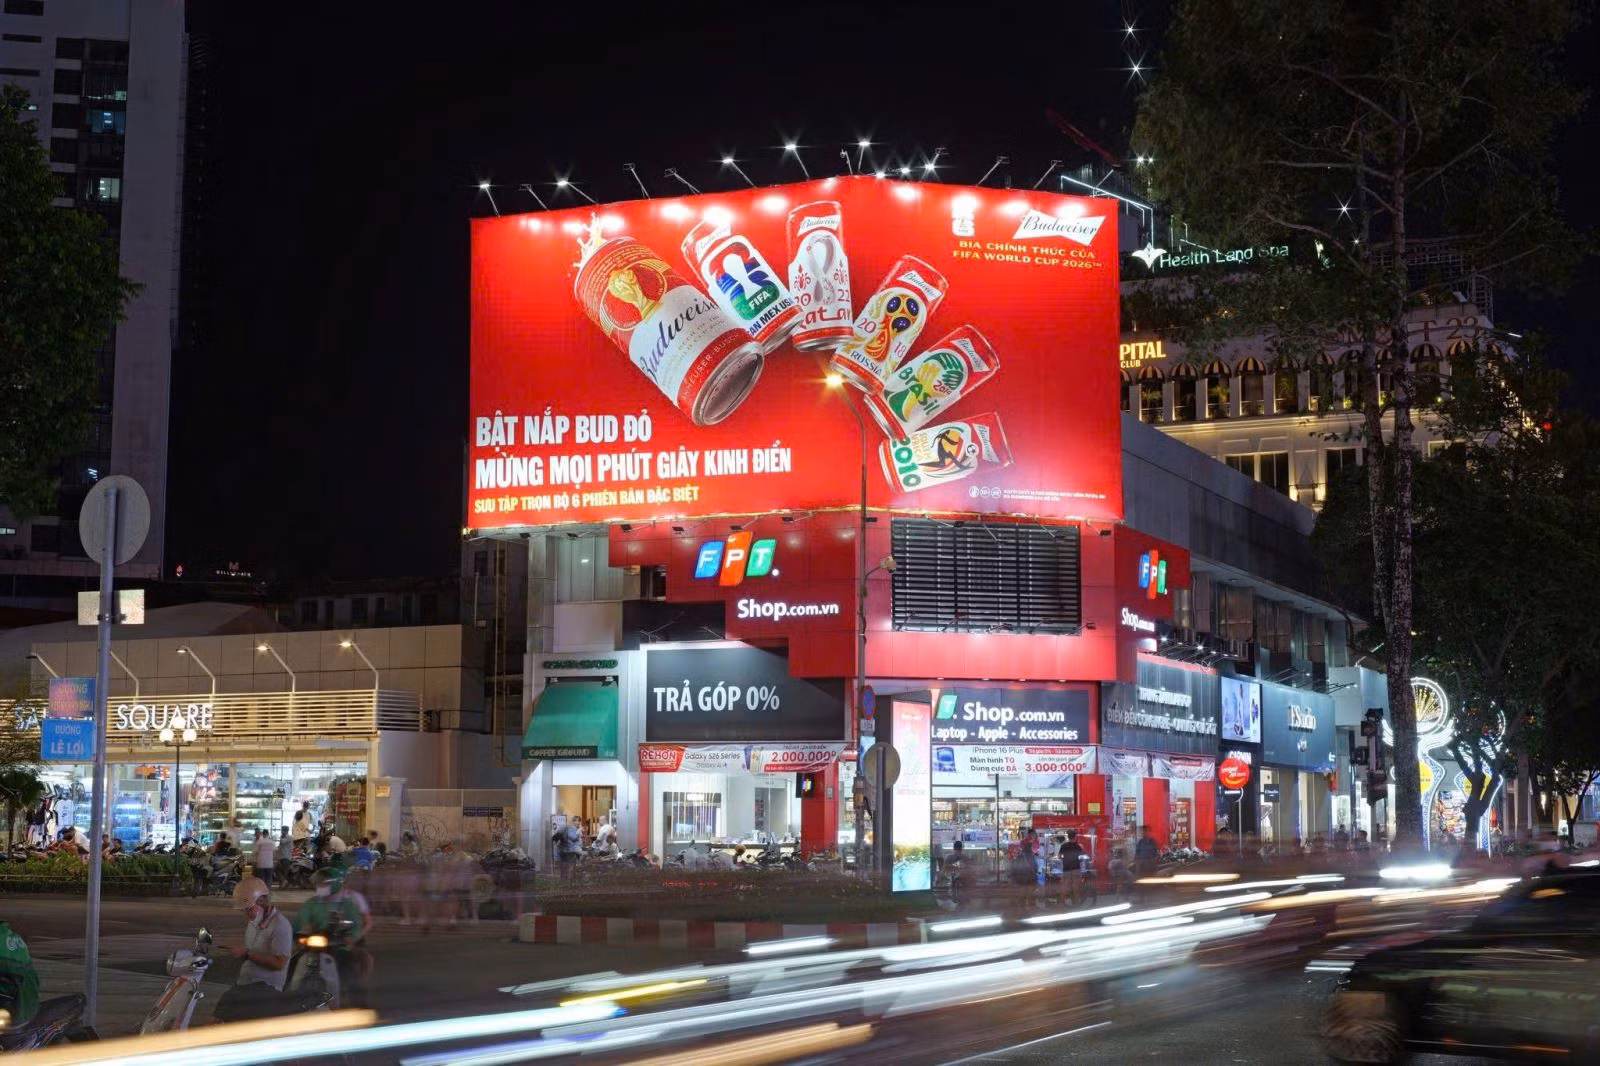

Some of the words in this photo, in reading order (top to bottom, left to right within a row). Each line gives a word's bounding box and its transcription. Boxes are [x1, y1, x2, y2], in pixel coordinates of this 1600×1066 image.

[1023, 214, 1097, 235] Budweiser
[959, 240, 981, 249] BIA
[986, 240, 1026, 252] CHÍNH
[952, 250, 980, 259] FIFA
[984, 252, 1030, 263] WORLD
[1034, 256, 1060, 265] CUP
[1160, 251, 1209, 269] Health
[748, 290, 770, 311] FIFA
[761, 306, 781, 327] MEX
[1120, 359, 1141, 369] CLUB
[476, 410, 519, 452] BẬT
[524, 406, 570, 445] NẮP
[575, 414, 619, 444] BUD
[623, 409, 652, 443] ĐỎ
[475, 451, 544, 489] MỪNG
[549, 453, 592, 489] MỌI
[597, 447, 653, 482] PHÚT
[656, 445, 699, 480] GIÂY
[704, 448, 748, 476] KINH
[752, 439, 791, 473] ĐIỂN
[497, 495, 519, 514] TẬP
[520, 495, 551, 513] TRỌN
[553, 491, 569, 511] BỘ
[572, 493, 580, 508] 6
[582, 488, 617, 507] PHIÊN
[672, 484, 699, 504] BIỆT
[737, 598, 839, 621] Shop.com.vn
[653, 679, 693, 712] TRẢ
[698, 681, 741, 712] GÓP
[746, 685, 780, 711] 0%
[116, 703, 214, 731] SQUARE
[931, 726, 967, 742] Laptop
[978, 726, 1008, 742] Apple
[1019, 727, 1078, 740] Accessories
[51, 739, 64, 754] LÊ
[972, 746, 998, 754] iPhone
[1008, 746, 1025, 754] Plus
